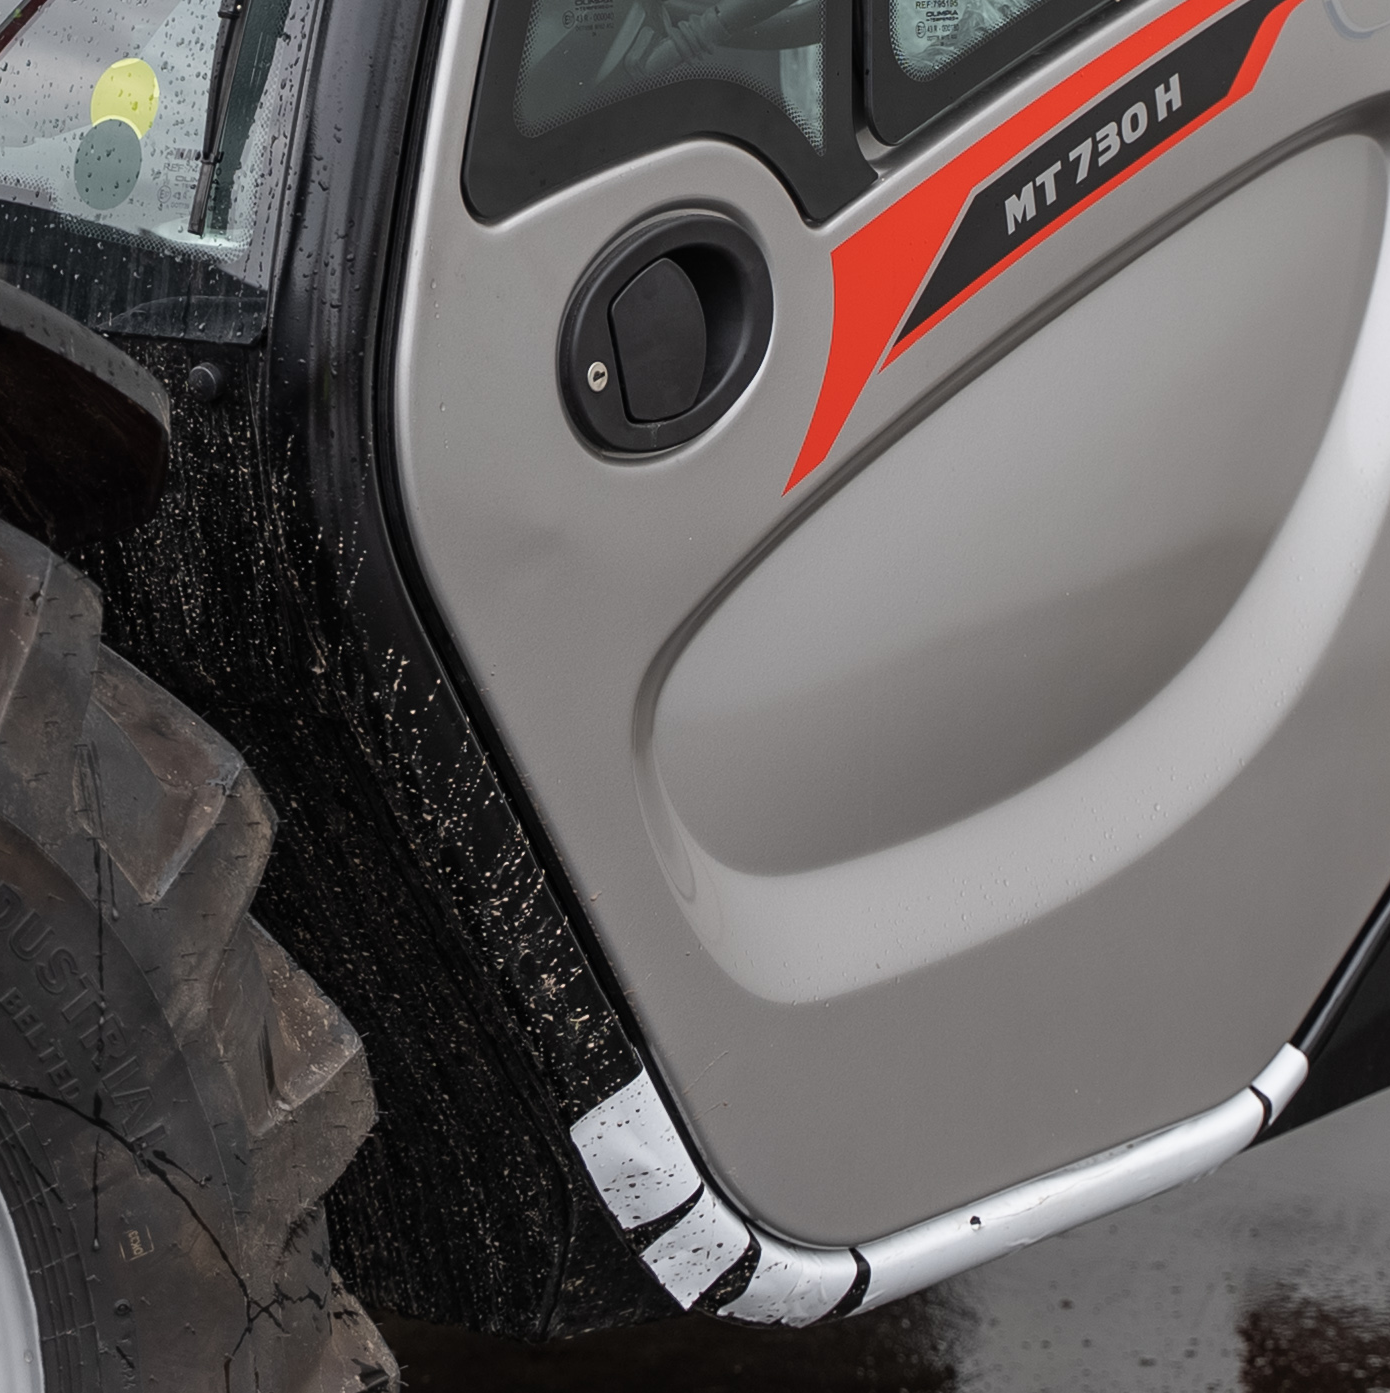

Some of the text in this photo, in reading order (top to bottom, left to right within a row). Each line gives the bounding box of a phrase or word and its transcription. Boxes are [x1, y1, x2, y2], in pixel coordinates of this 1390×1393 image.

[1003, 72, 1183, 236] MT 730 H
